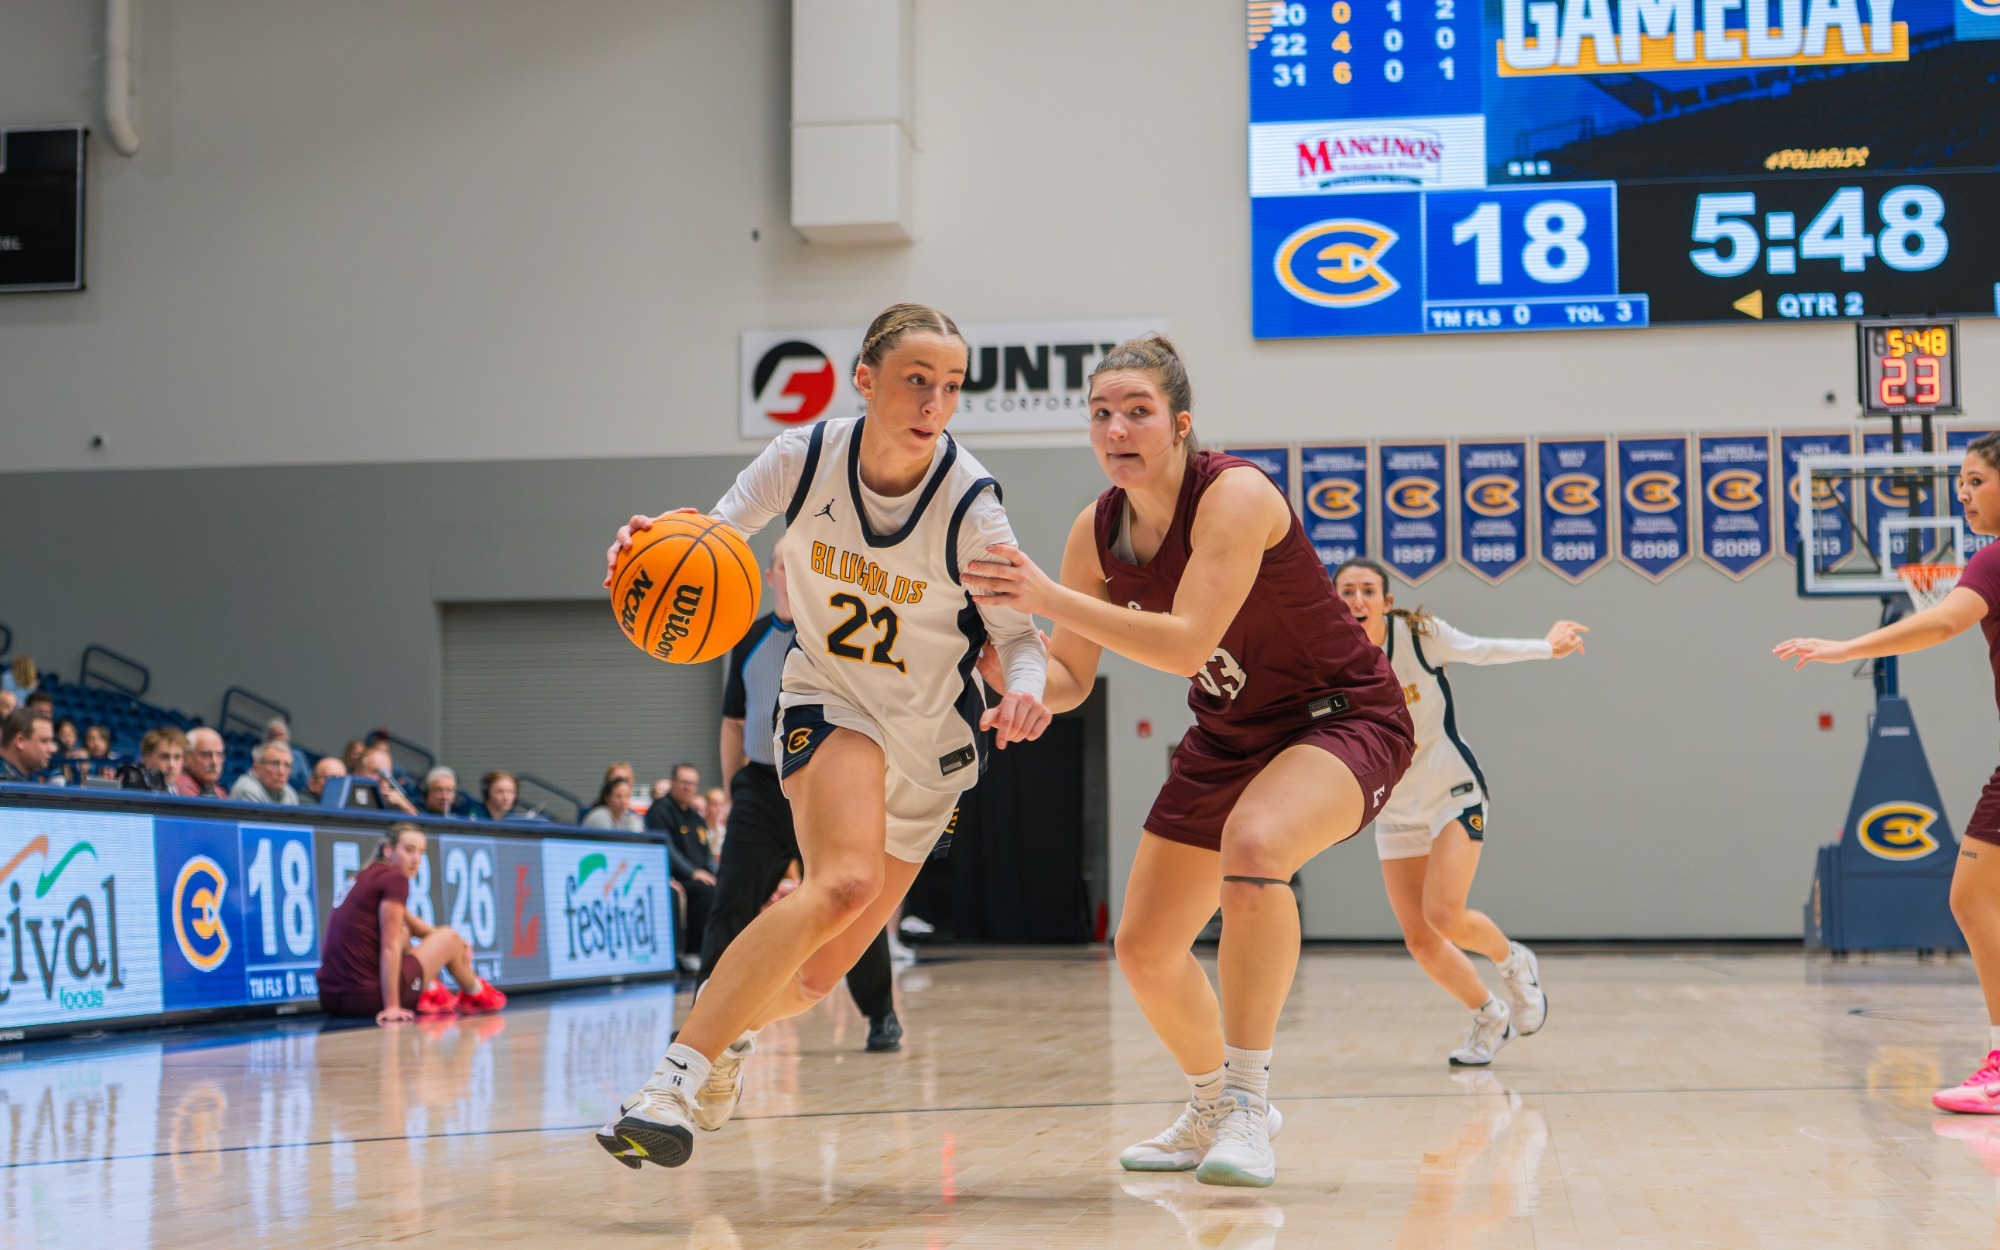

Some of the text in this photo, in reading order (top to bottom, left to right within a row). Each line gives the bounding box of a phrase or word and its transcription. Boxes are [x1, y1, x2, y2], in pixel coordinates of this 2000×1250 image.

[1270, 0, 1455, 27] 20 0 1 2
[1503, 0, 1896, 69] GAMEDAY
[1270, 26, 1456, 57] 22 4 0 0
[1272, 56, 1455, 88] 31 6 0 1
[1452, 199, 1591, 286] 18
[1689, 184, 1949, 278] 5:48
[1431, 304, 1531, 328] TM FLS 0
[1564, 300, 1634, 324] TOL 3
[1777, 291, 1865, 318] QTR 2
[1887, 327, 1948, 358] 5:48
[1881, 356, 1941, 405] 23
[811, 540, 927, 604] BLUGOLDS
[1551, 541, 1596, 561] 2001
[1711, 538, 1762, 558] 2009
[653, 584, 704, 659] Wilson
[826, 592, 908, 675] 22
[248, 838, 315, 956] 18
[446, 848, 497, 948] 26
[564, 874, 658, 961] festival
[0, 874, 125, 1002] ival
[59, 986, 104, 1010] foods
